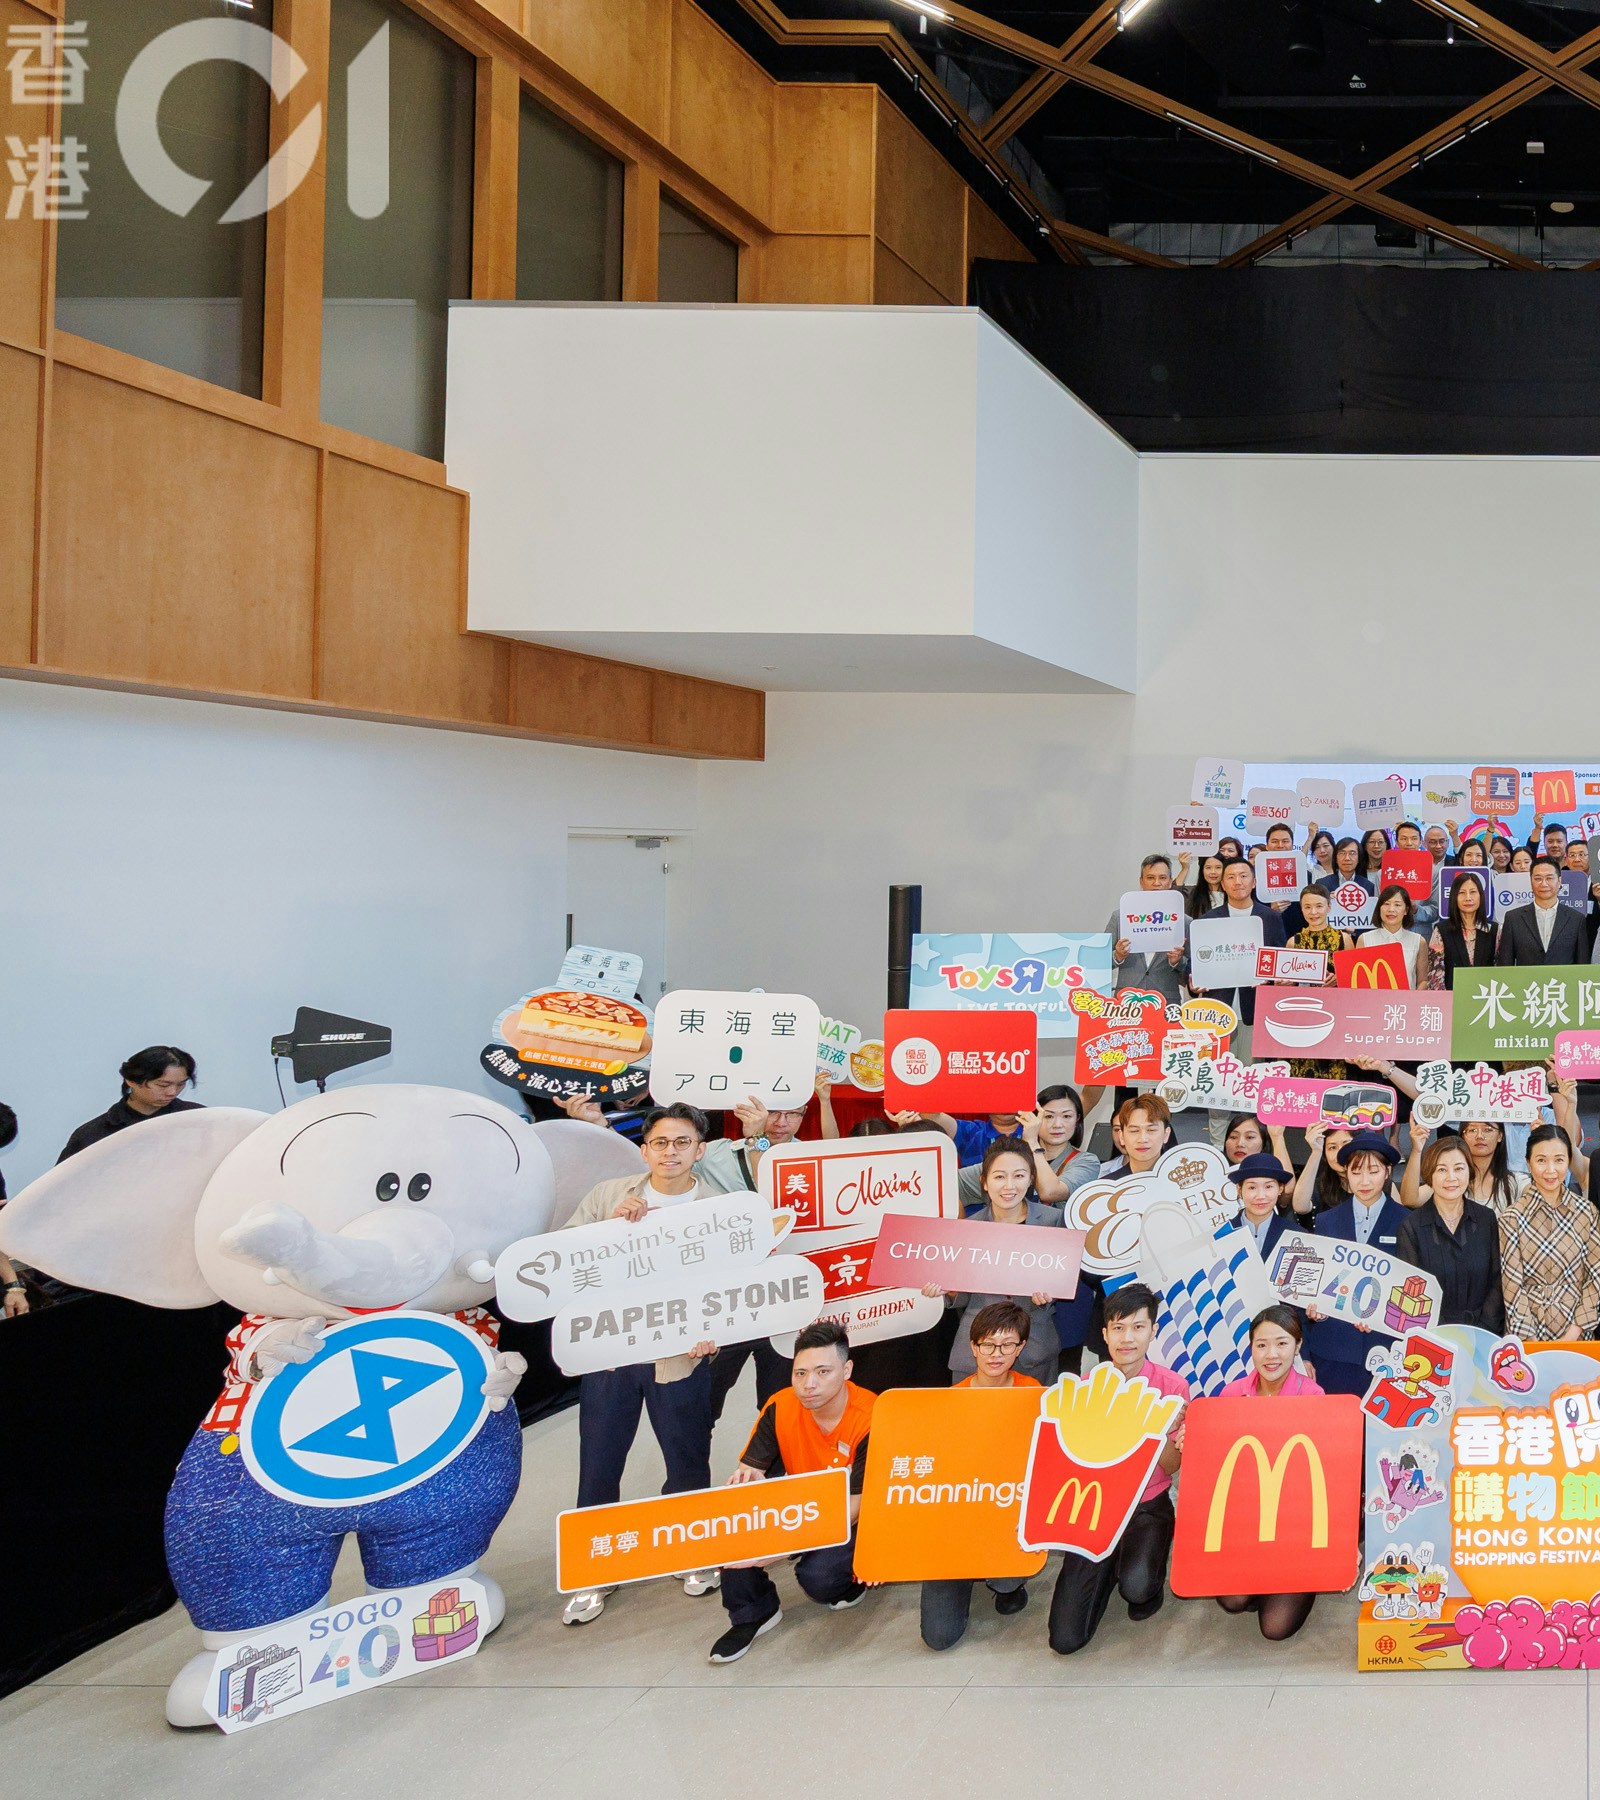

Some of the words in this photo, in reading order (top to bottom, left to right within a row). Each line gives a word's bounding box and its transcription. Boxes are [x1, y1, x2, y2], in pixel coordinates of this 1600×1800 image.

[1314, 798, 1340, 806] ZAKURA
[1358, 796, 1398, 808] 日本命力
[1440, 796, 1458, 804] Indo
[1474, 800, 1515, 810] FORTRESS
[581, 953, 630, 972] 東海堂
[679, 1008, 797, 1037] 東海堂
[1102, 1002, 1142, 1020] Indo
[1345, 1004, 1443, 1032] 一粥麵
[320, 1032, 366, 1042] SHURE
[1344, 1033, 1391, 1045] Super
[1395, 1034, 1442, 1046] Super
[1494, 1034, 1549, 1048] mixian
[526, 1072, 597, 1096] 流心芝士
[611, 1071, 648, 1094] 鮮芒
[675, 1073, 791, 1092] アローム
[1419, 1064, 1549, 1109] 環島中港通
[1262, 1088, 1320, 1109] 環島中港通
[836, 1167, 922, 1215] Maxim's
[570, 1226, 676, 1266] maxim's
[682, 1210, 754, 1242] cakes
[572, 1228, 755, 1294] 美心西餅
[889, 1242, 963, 1262] CHOW
[968, 1247, 1001, 1266] TAI
[1008, 1251, 1068, 1271] FOOK
[1332, 1245, 1391, 1276] SOGO
[570, 1297, 687, 1344] PAPER
[701, 1274, 809, 1318] STONE
[857, 1298, 915, 1321] GARDEN
[627, 1310, 759, 1346] BAKERY
[889, 1456, 935, 1479] 萬寧
[886, 1478, 1024, 1509] mannings
[590, 1530, 640, 1559] 萬寧
[653, 1501, 820, 1549] mannings
[1455, 1528, 1528, 1548] HONG
[1454, 1551, 1537, 1566] SHOPPING
[308, 1597, 403, 1641] SOGO
[1367, 1655, 1404, 1665] HKRMA
